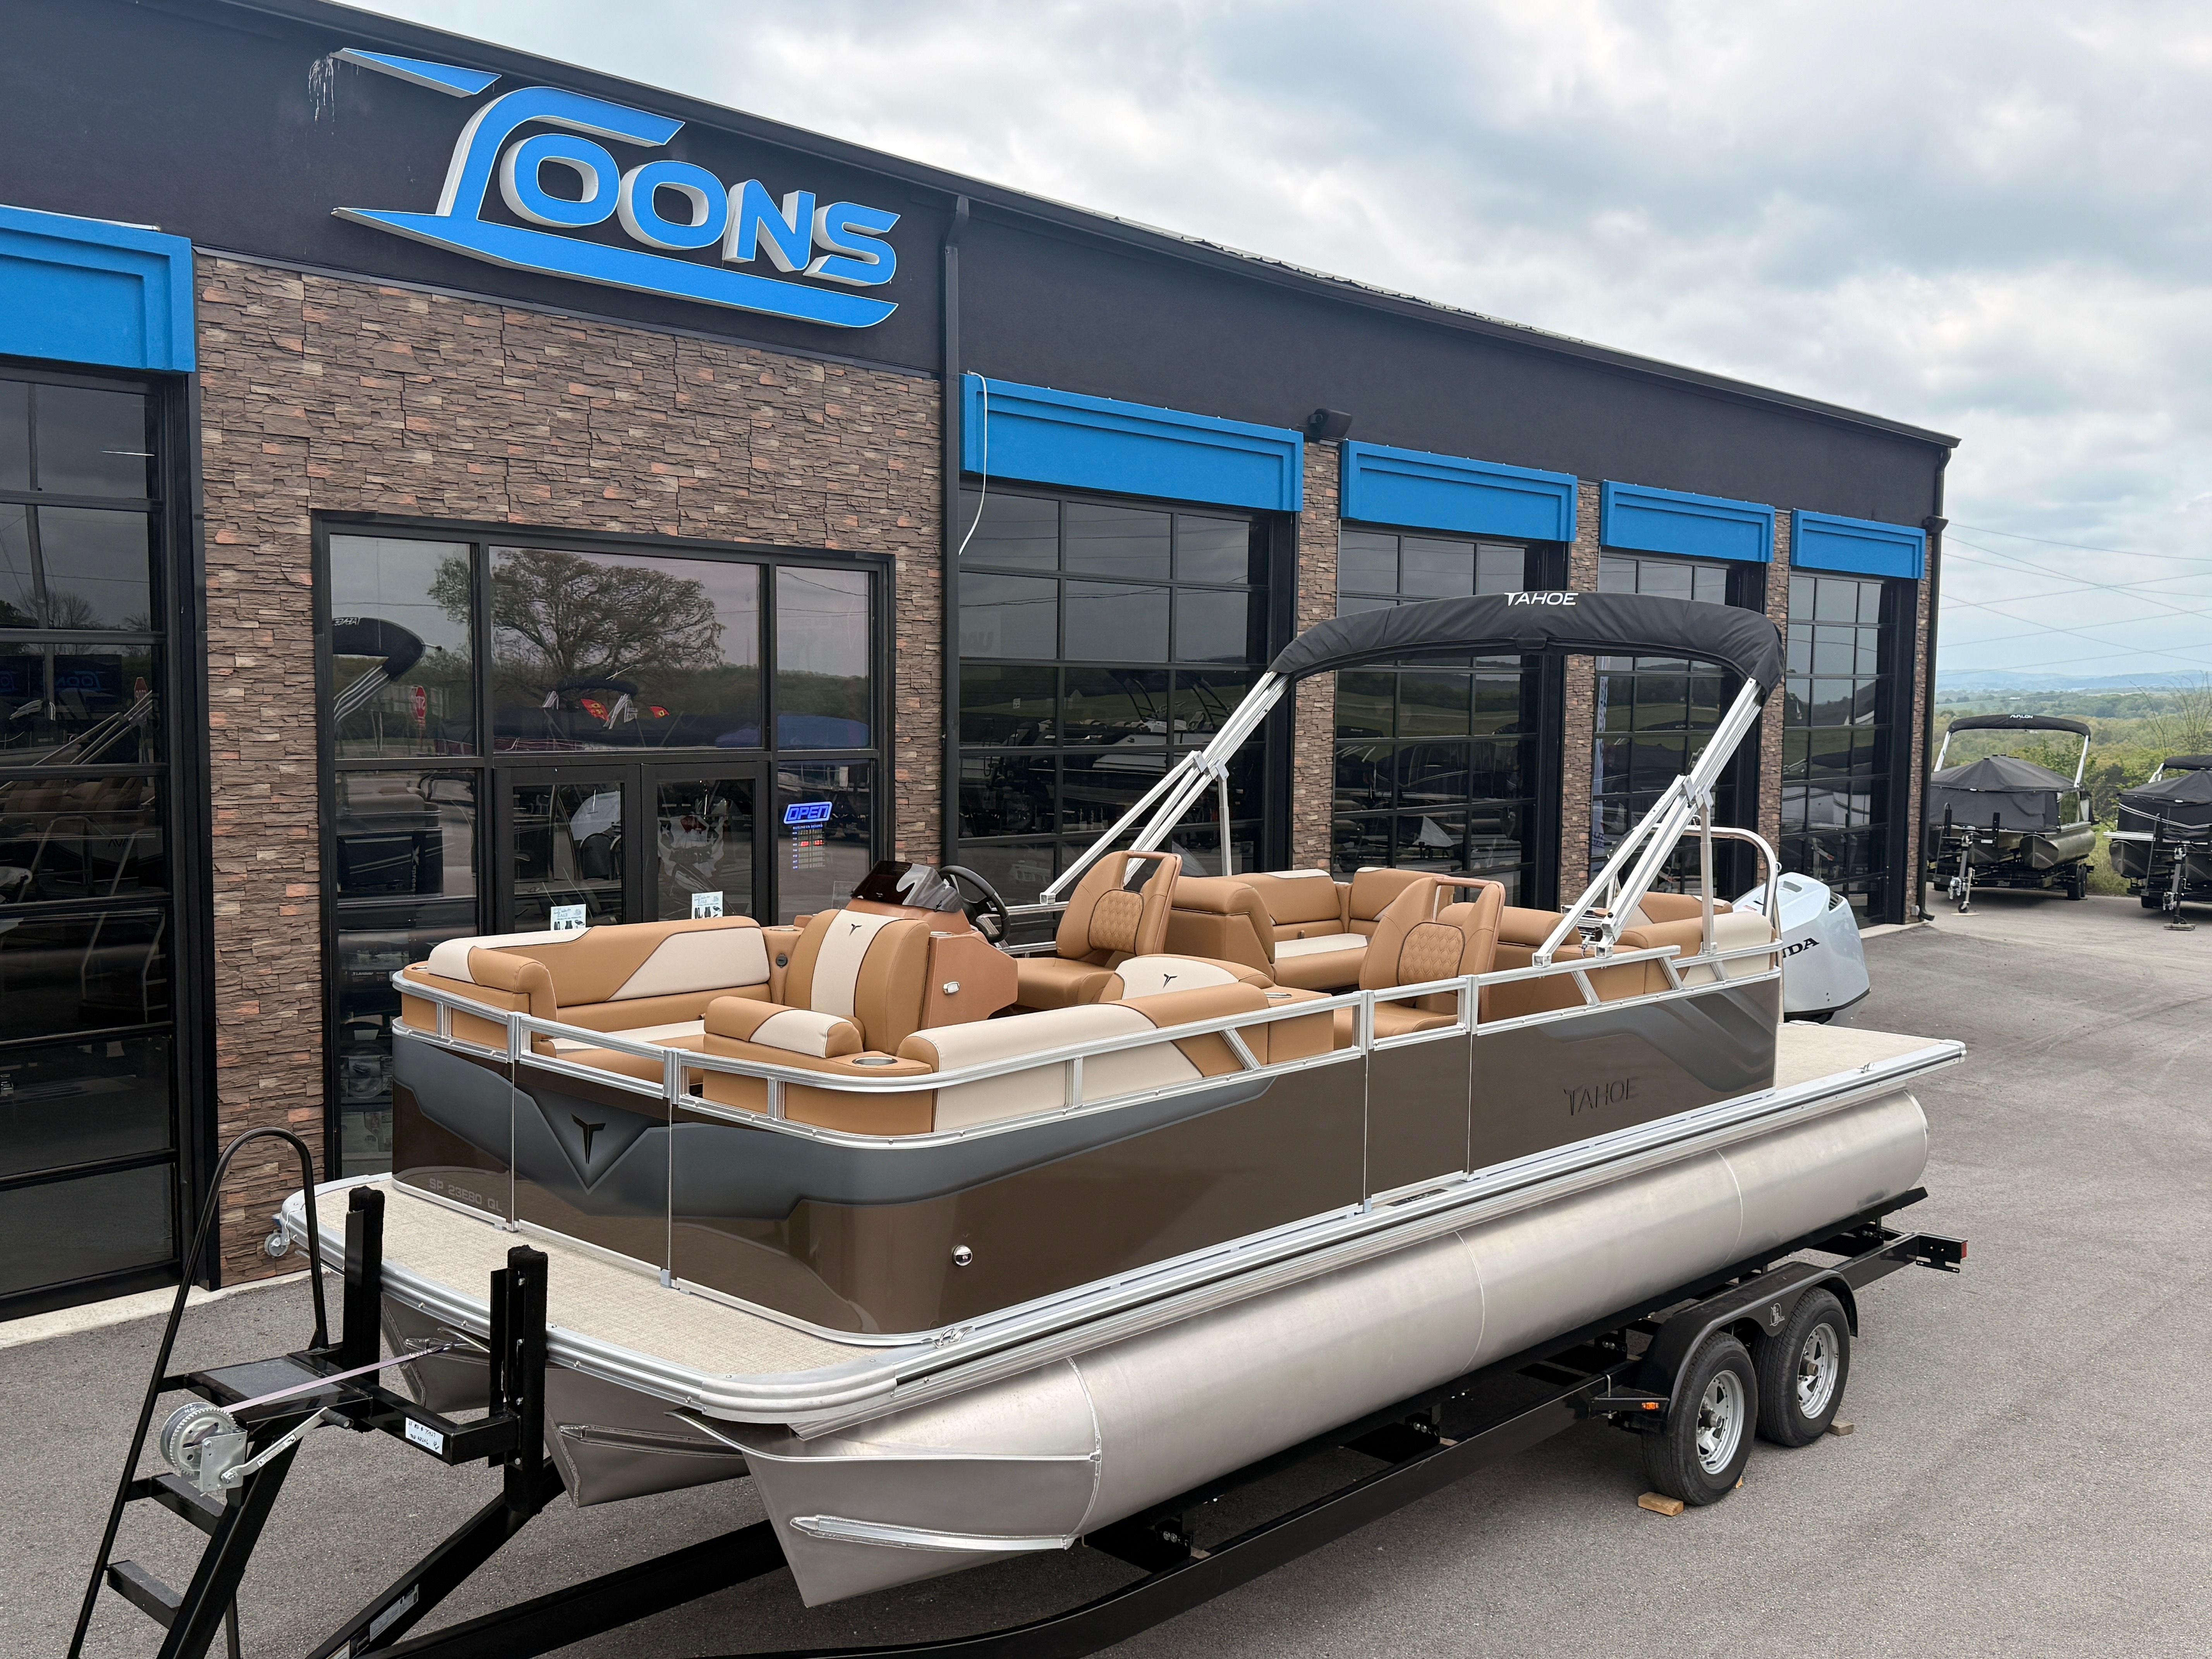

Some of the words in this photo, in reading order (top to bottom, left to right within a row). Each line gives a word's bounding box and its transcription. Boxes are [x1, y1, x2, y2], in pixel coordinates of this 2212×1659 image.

[331, 85, 902, 328] LOONS
[1504, 592, 1579, 606] TAHOE
[788, 805, 829, 820] OPEN
[1564, 1076, 1640, 1116] TAHOE
[429, 1178, 444, 1190] SP
[488, 1198, 502, 1212] QL
